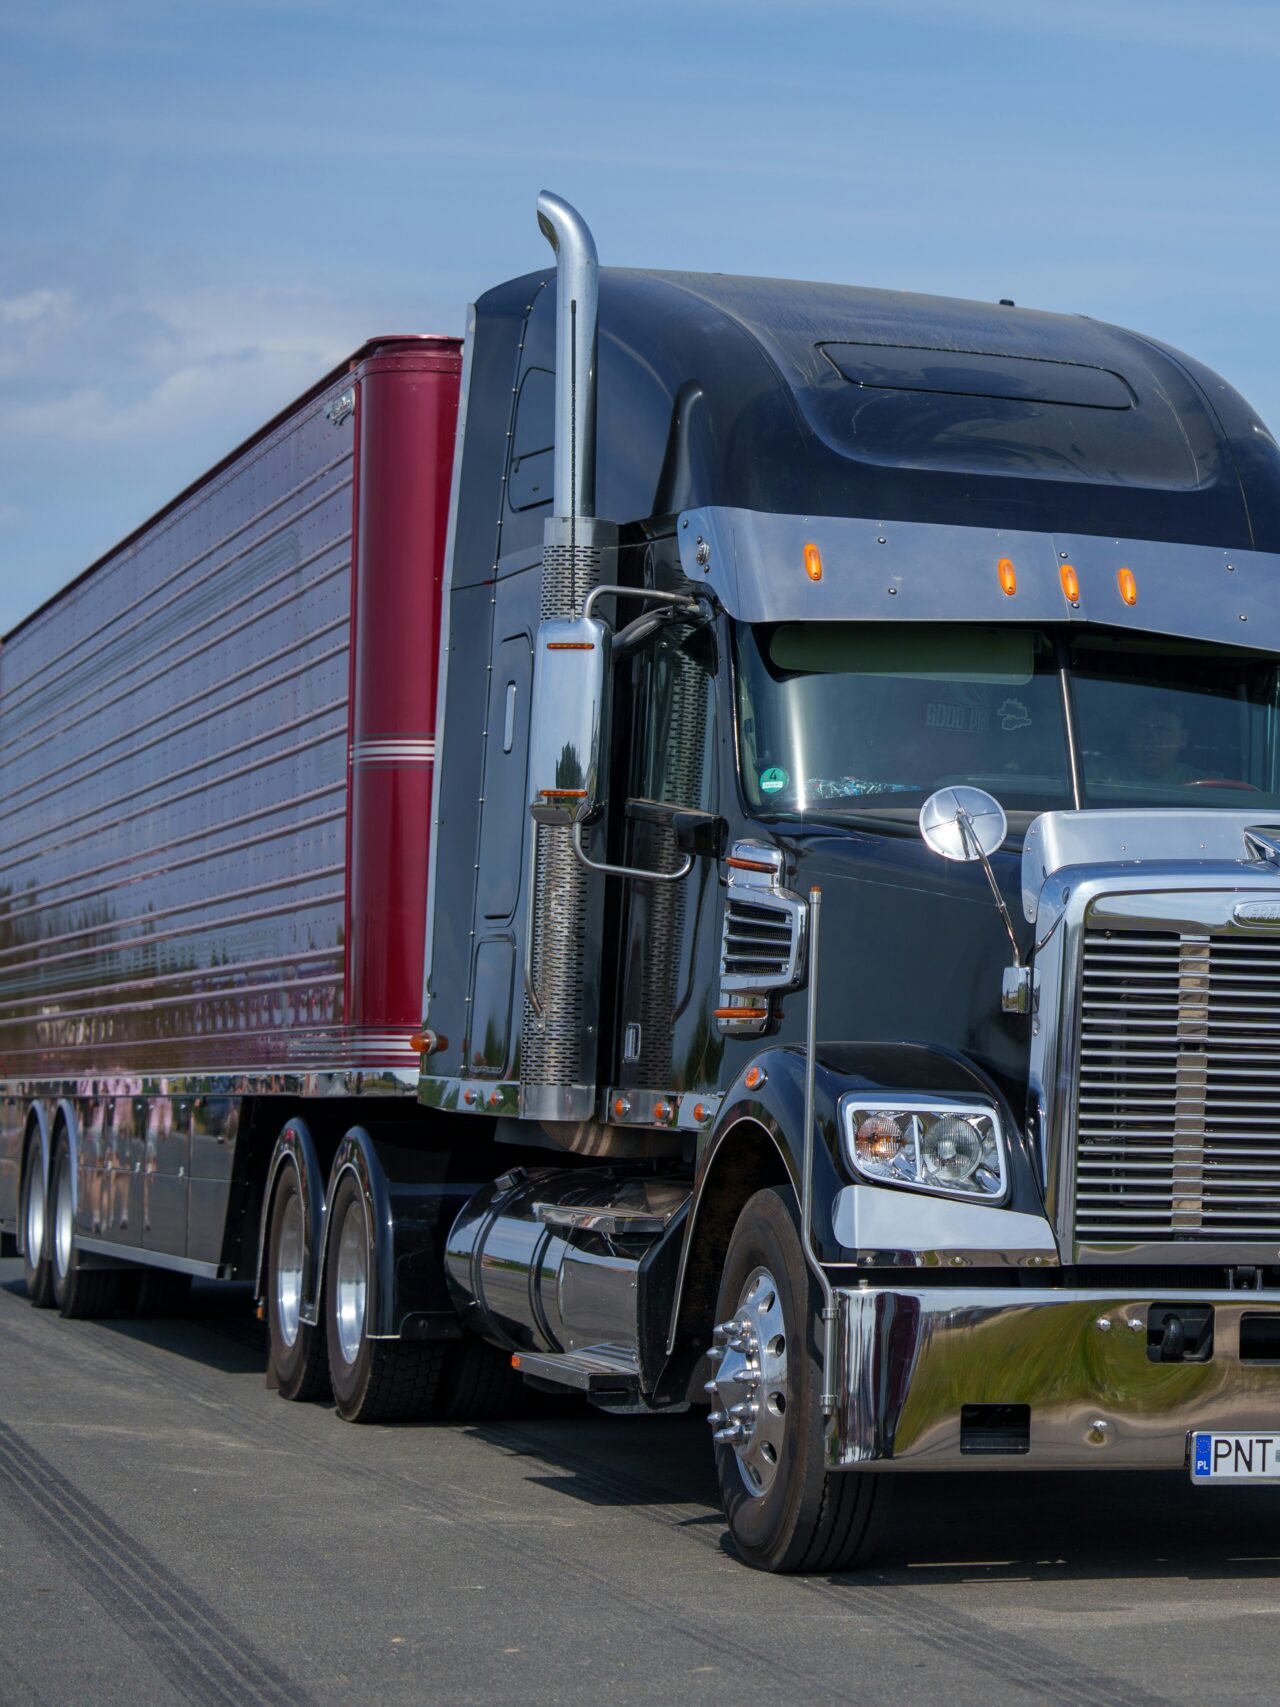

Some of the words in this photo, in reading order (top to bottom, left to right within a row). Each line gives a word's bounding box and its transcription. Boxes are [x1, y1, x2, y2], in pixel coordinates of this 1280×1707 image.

[769, 769, 777, 781] 4
[1213, 1439, 1273, 1472] PNT
[1197, 1460, 1208, 1470] PL
